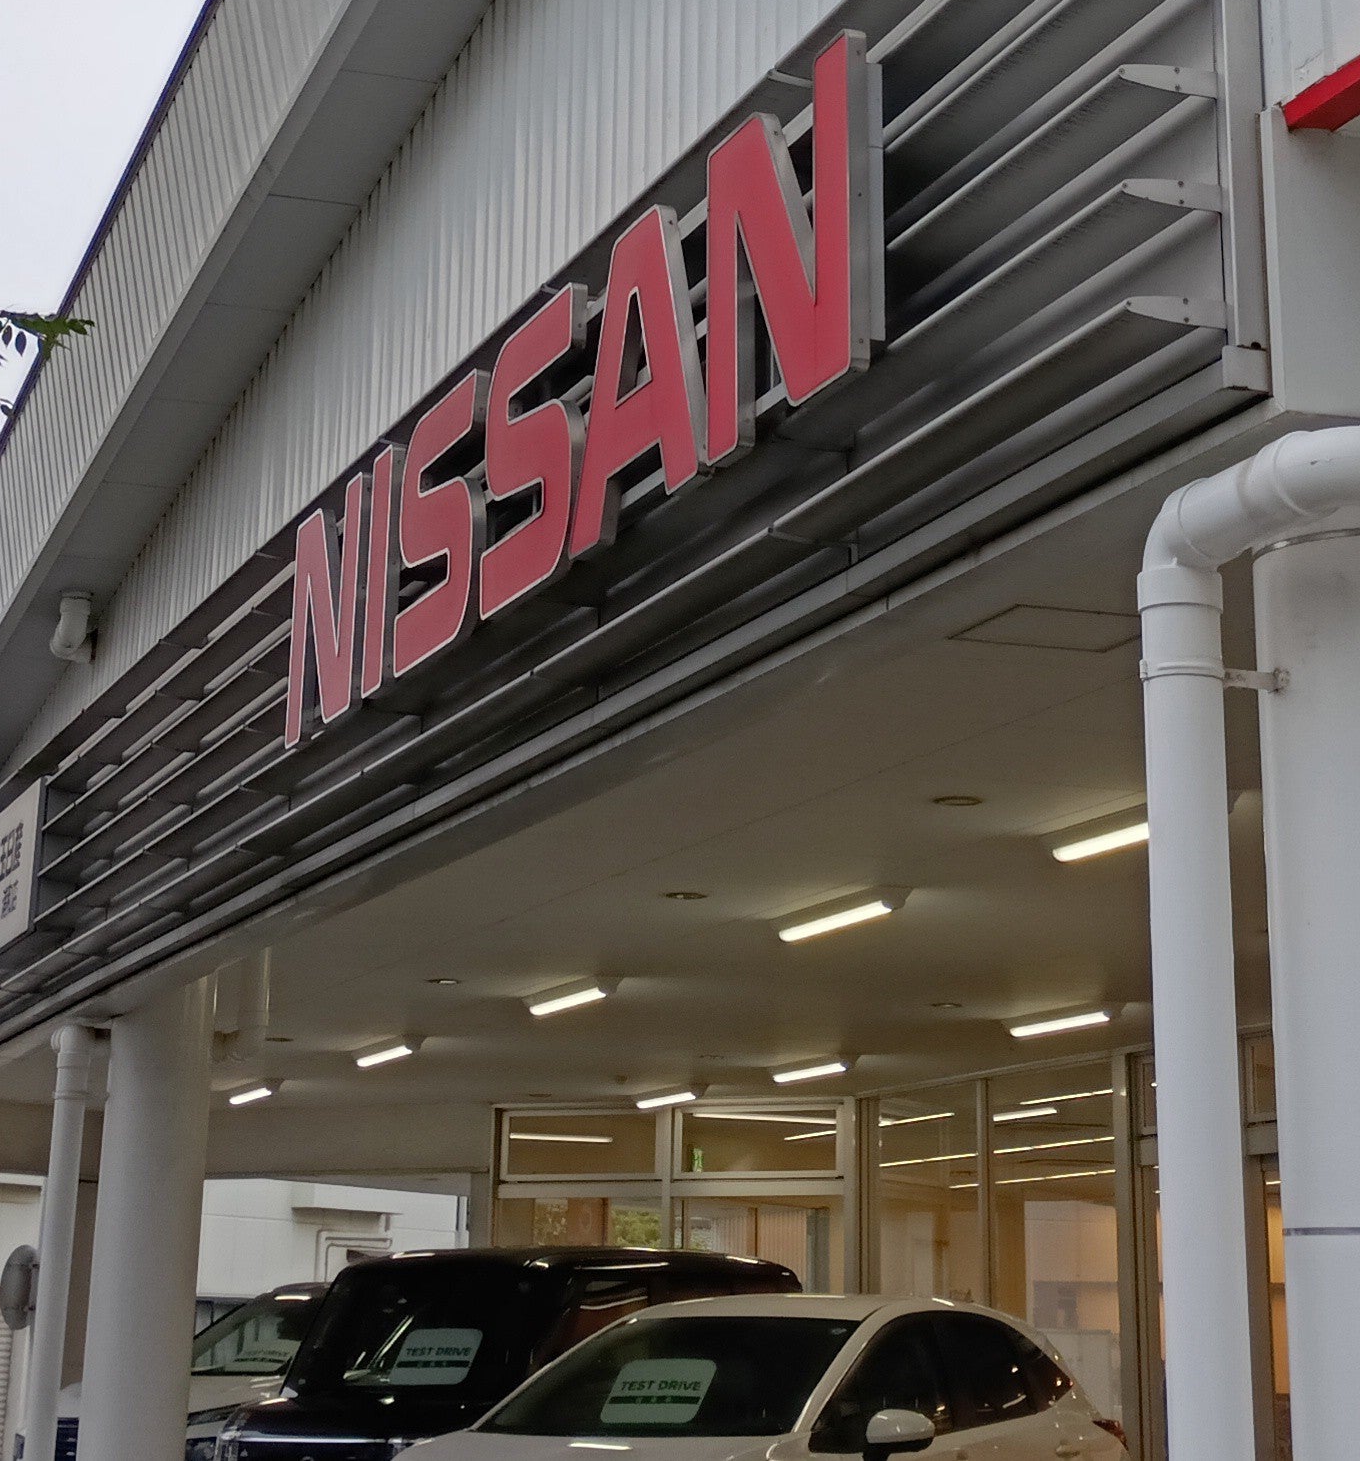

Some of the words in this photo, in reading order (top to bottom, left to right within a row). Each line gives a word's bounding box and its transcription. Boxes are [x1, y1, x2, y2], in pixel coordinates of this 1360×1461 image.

[285, 28, 868, 749] NISSAN
[406, 1346, 435, 1356] TEST
[435, 1346, 473, 1356] DRIVE
[621, 1380, 655, 1391] TEST
[658, 1380, 701, 1391] DRIVE
